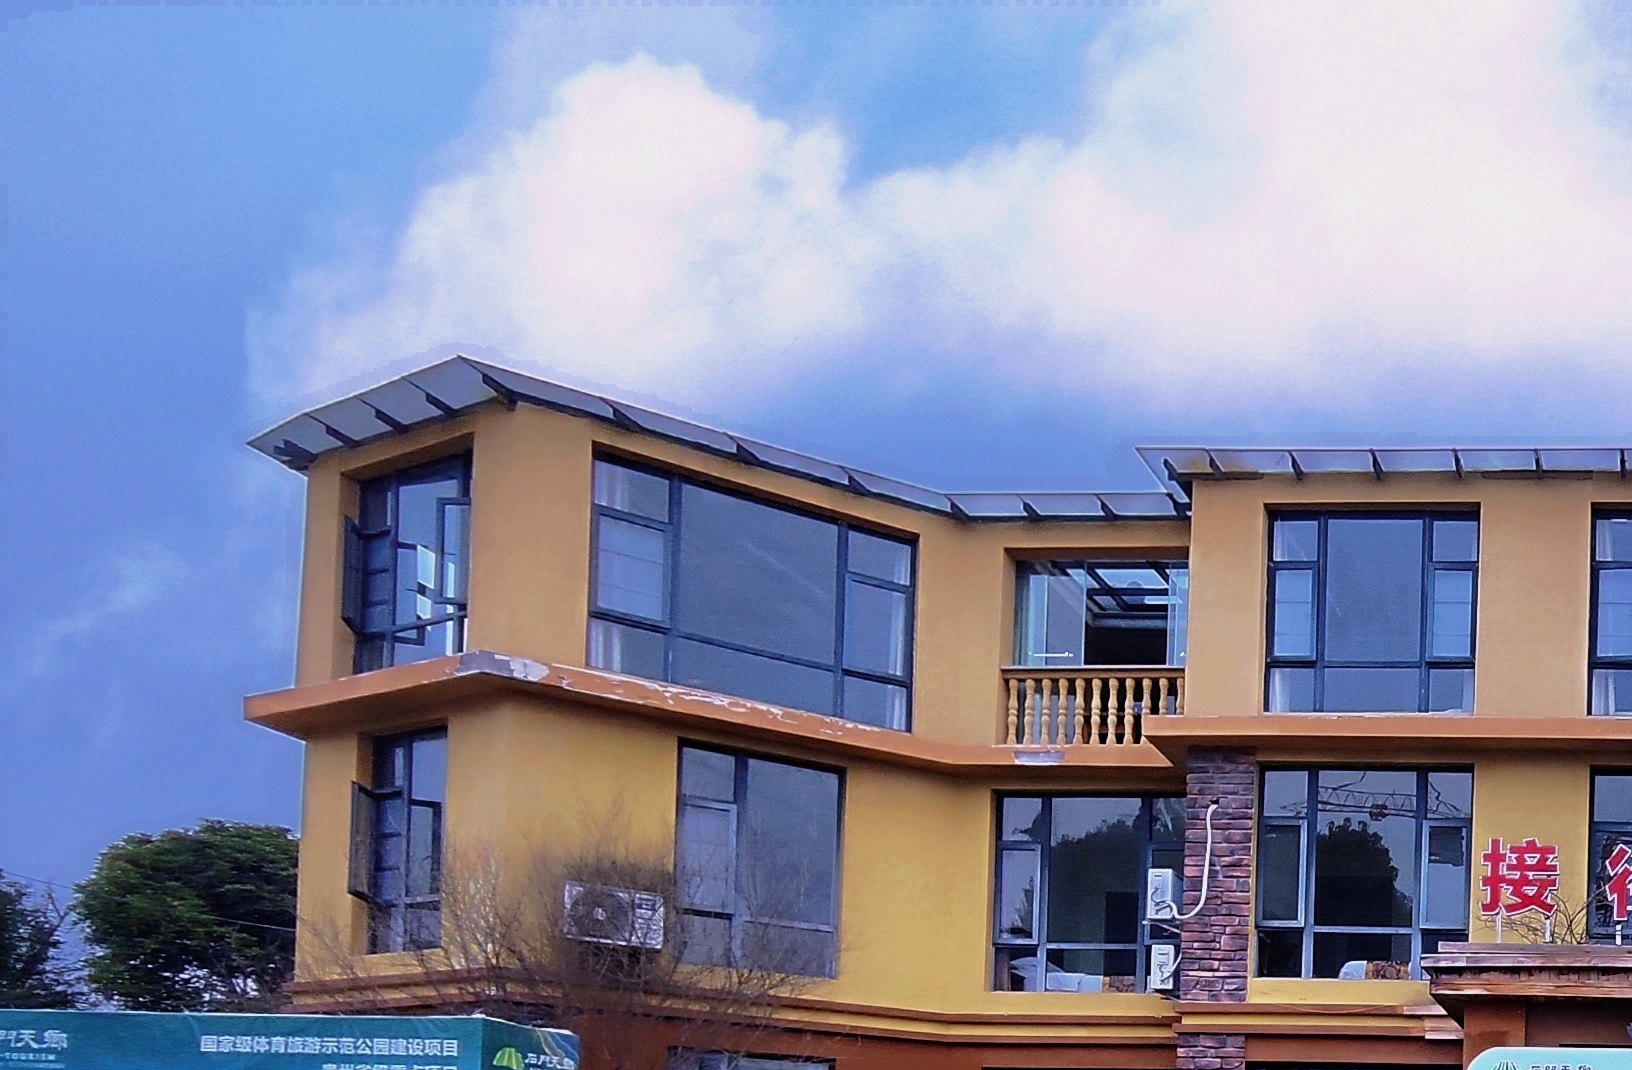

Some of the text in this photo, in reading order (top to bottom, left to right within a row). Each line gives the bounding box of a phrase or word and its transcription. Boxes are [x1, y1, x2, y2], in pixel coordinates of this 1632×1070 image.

[200, 1035, 459, 1057] 国家级体育旅游示范公园建设项目
